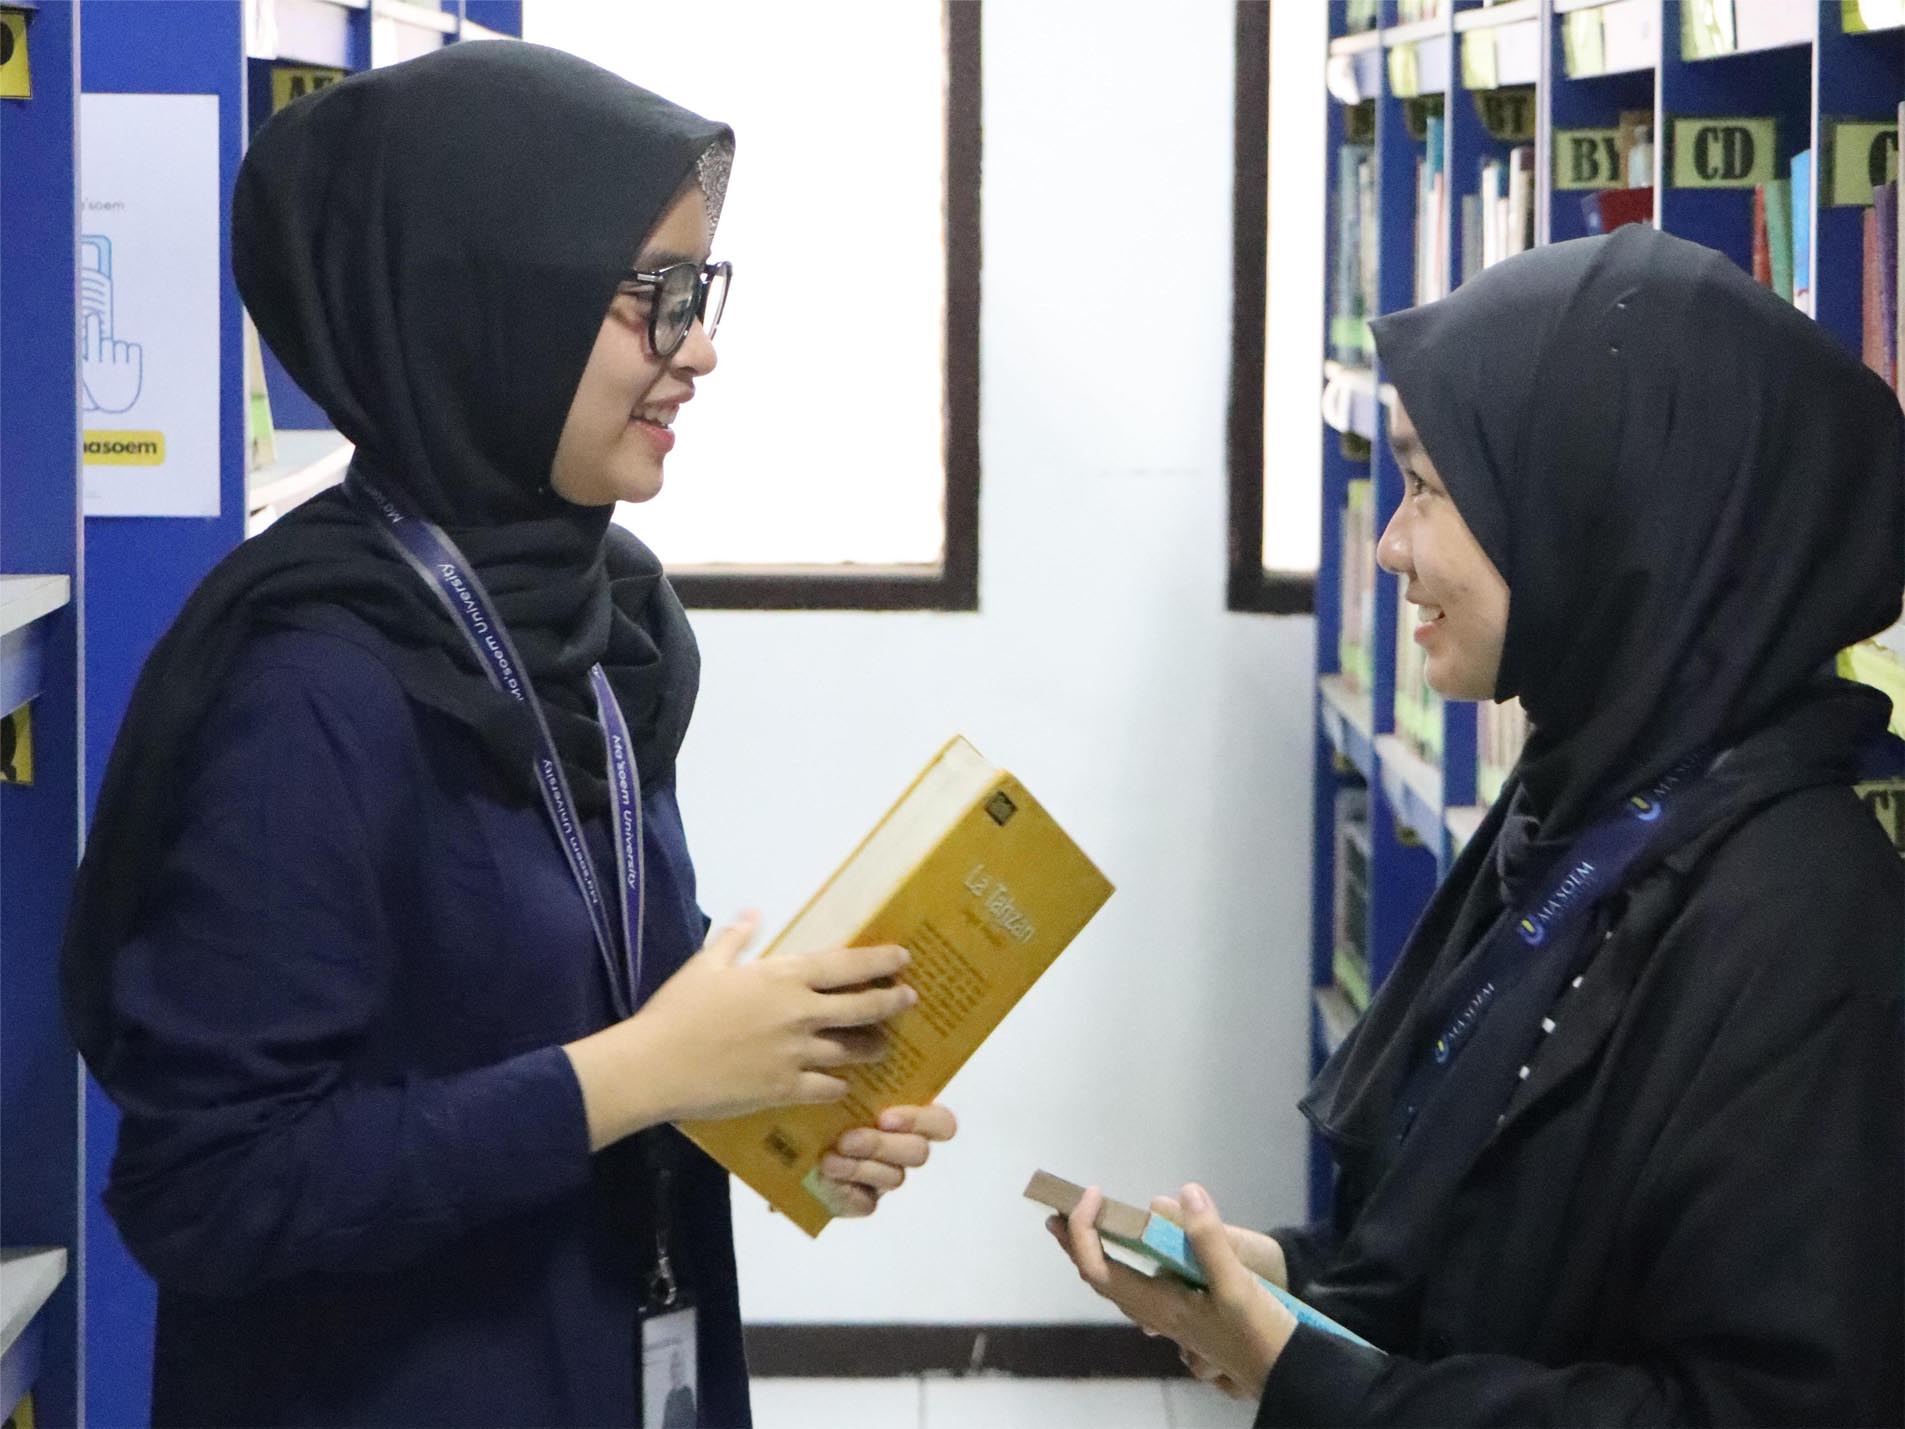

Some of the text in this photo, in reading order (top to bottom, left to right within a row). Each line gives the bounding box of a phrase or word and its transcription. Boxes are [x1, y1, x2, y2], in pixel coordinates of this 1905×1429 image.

[1570, 137, 1620, 182] BY
[1694, 126, 1755, 180] CD
[437, 563, 525, 701] Ma'soem University
[543, 759, 573, 835] University
[612, 734, 637, 890] Ma'soem University
[963, 863, 989, 897] La
